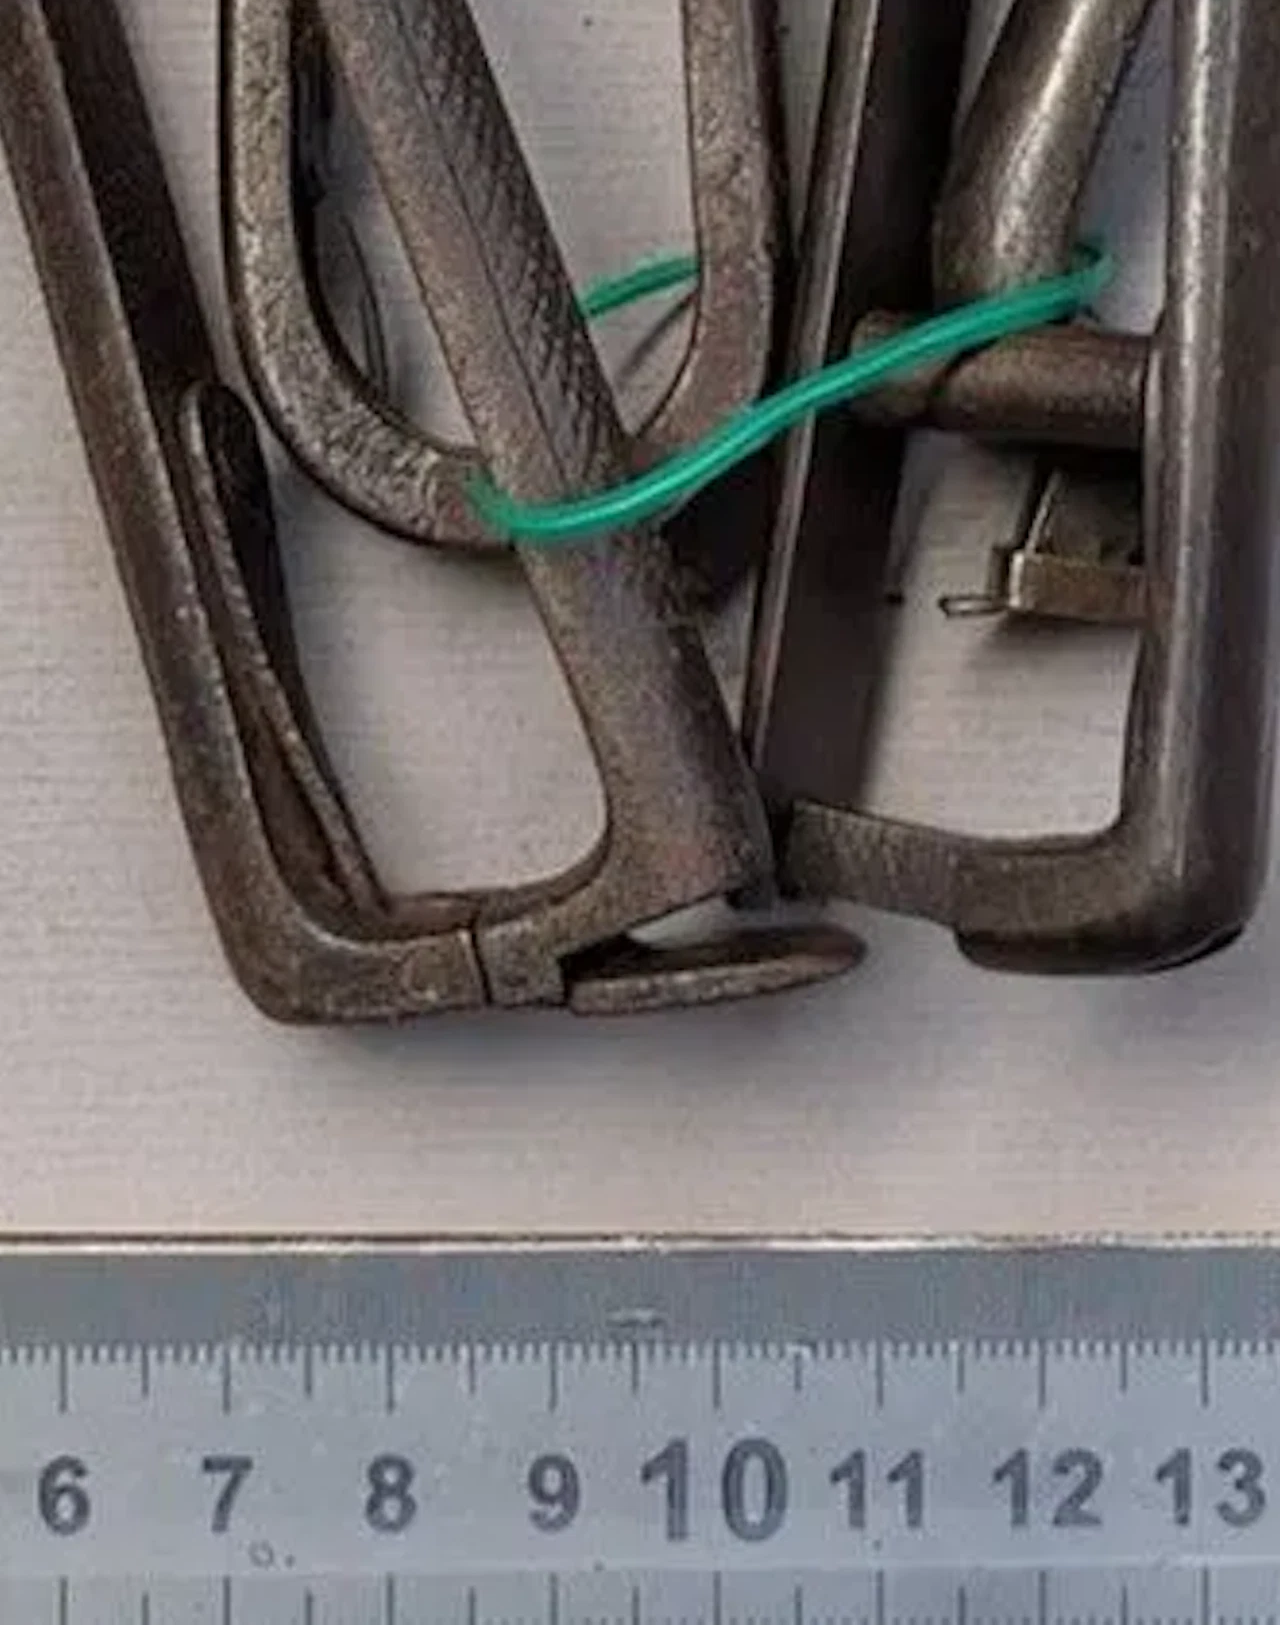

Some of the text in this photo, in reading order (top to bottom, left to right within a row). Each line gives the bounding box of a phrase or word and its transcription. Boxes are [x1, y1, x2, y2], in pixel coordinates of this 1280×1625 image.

[39, 1456, 89, 1534] 6
[202, 1457, 253, 1532] 7
[366, 1455, 416, 1532] 8
[528, 1455, 580, 1530] 9
[641, 1439, 787, 1541] 10
[829, 1449, 923, 1528] 11
[993, 1449, 1102, 1527] 12
[1155, 1449, 1265, 1526] 13
